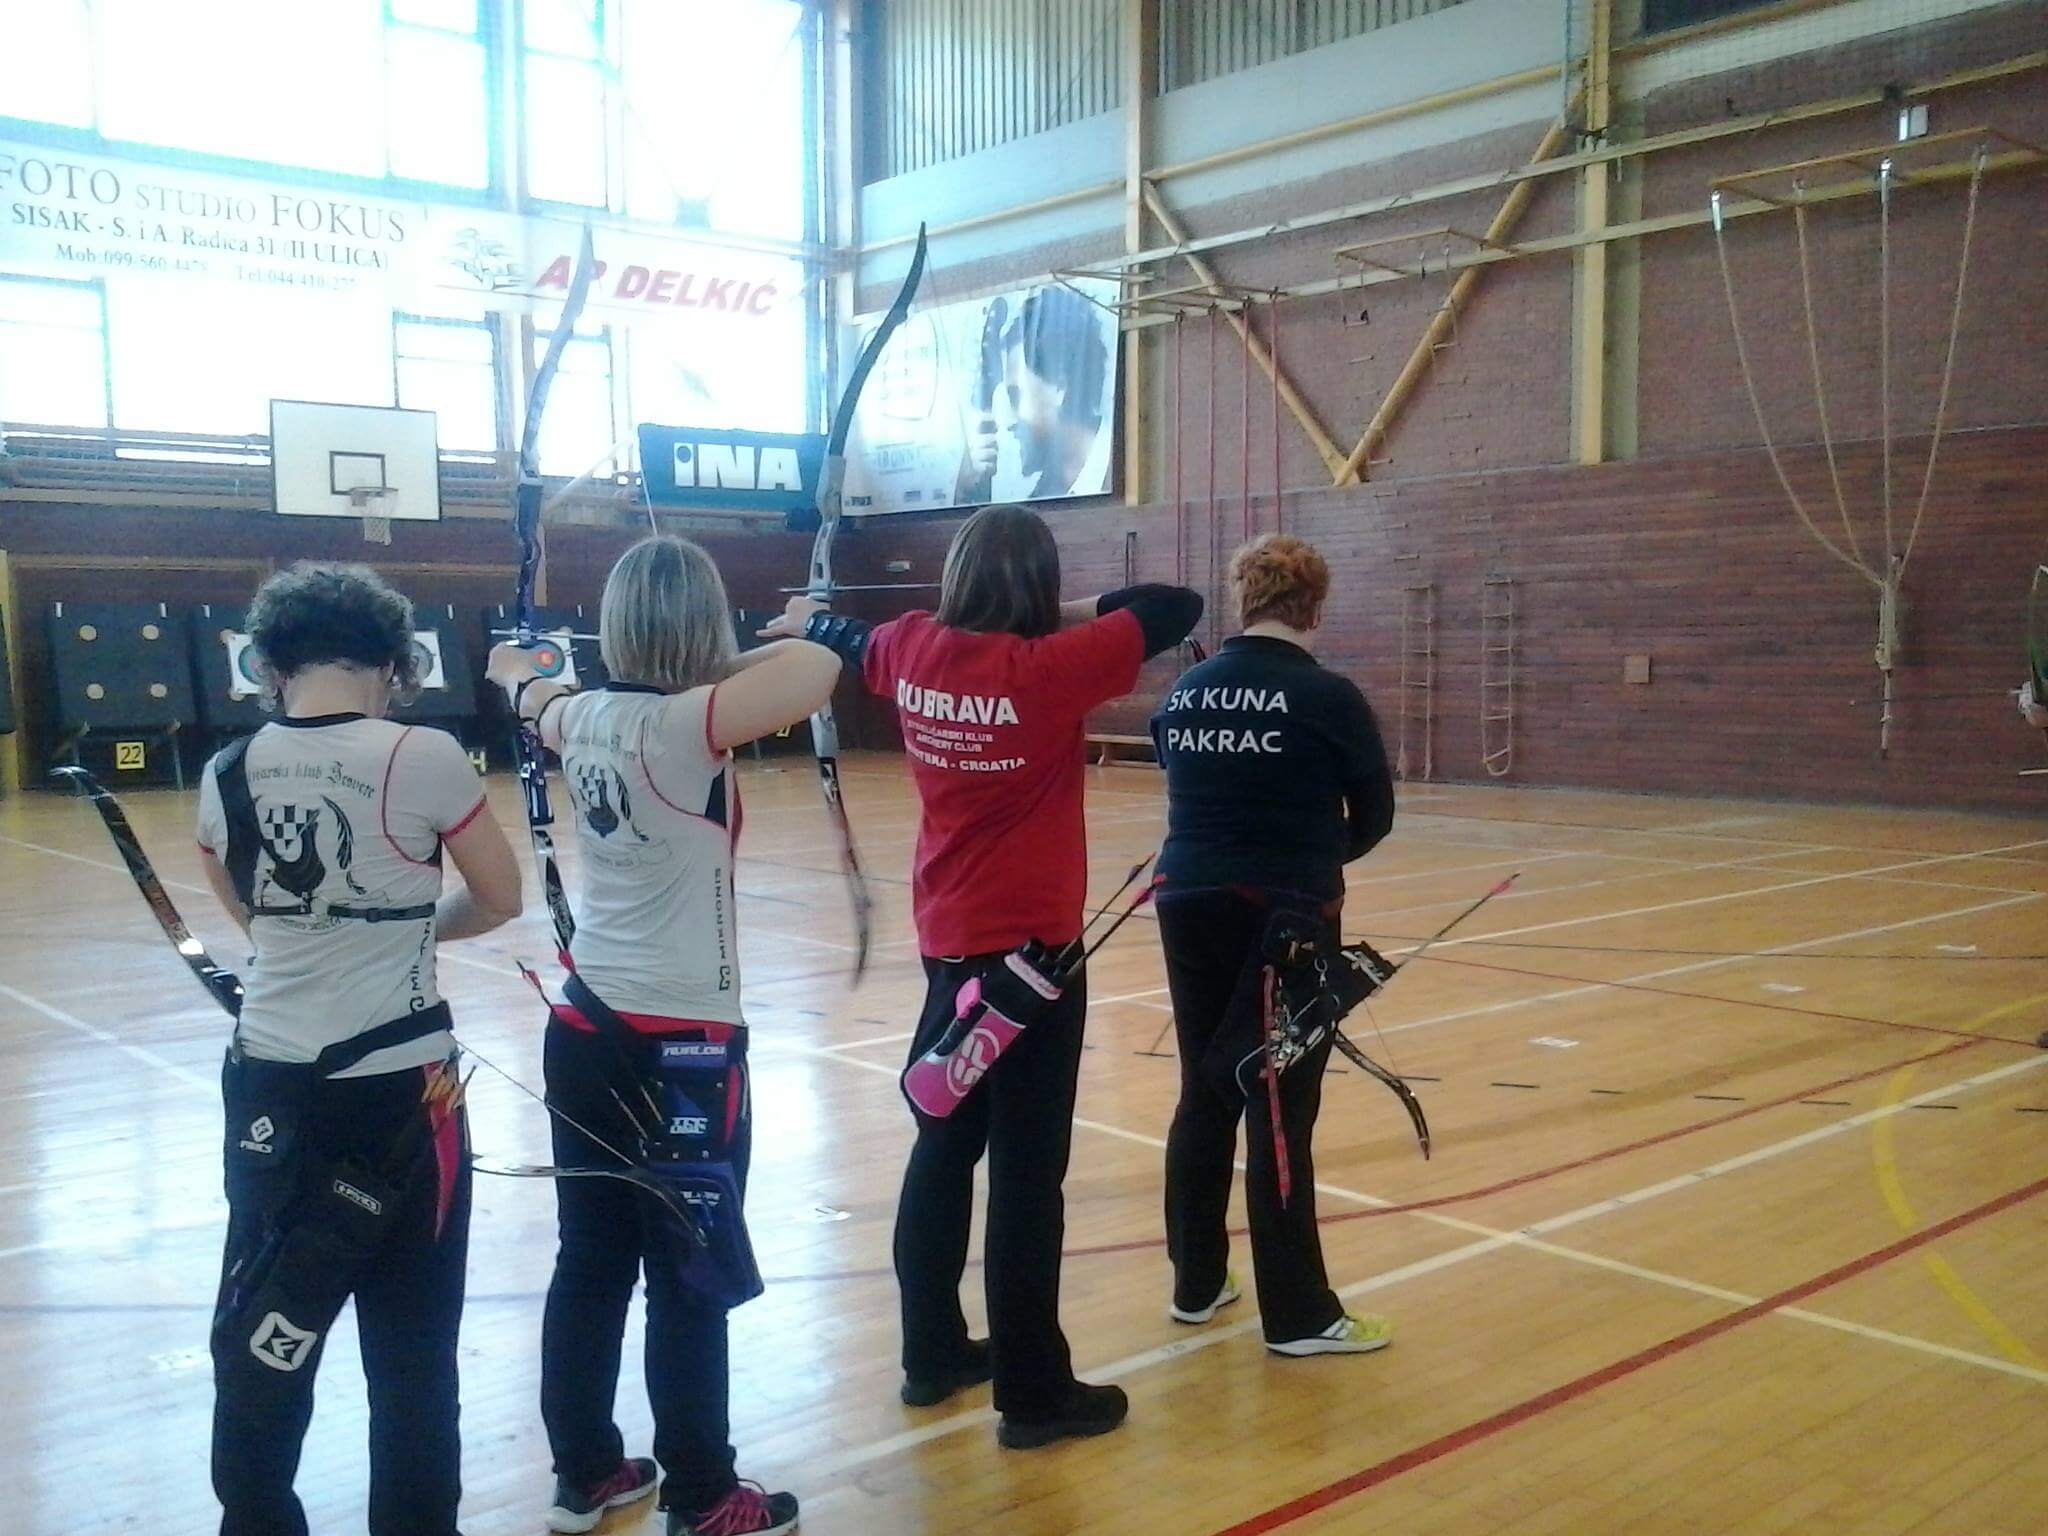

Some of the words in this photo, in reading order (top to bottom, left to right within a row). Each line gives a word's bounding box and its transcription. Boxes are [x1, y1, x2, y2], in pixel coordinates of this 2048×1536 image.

[136, 184, 256, 223] STUDIO
[271, 194, 405, 243] FOKUS
[12, 203, 91, 234] SISAK
[256, 237, 275, 256] 31
[614, 265, 777, 314] DELKIĆ
[897, 678, 1020, 725] DUBRAVA
[1167, 688, 1197, 712] SK
[1201, 687, 1288, 713] KUNA
[916, 732, 953, 751] ARCHERY
[954, 742, 982, 752] CLUB
[965, 732, 993, 742] KLUB
[1167, 728, 1283, 753] PAKRAC
[120, 745, 141, 765] 22
[959, 756, 1026, 771] CROATIA
